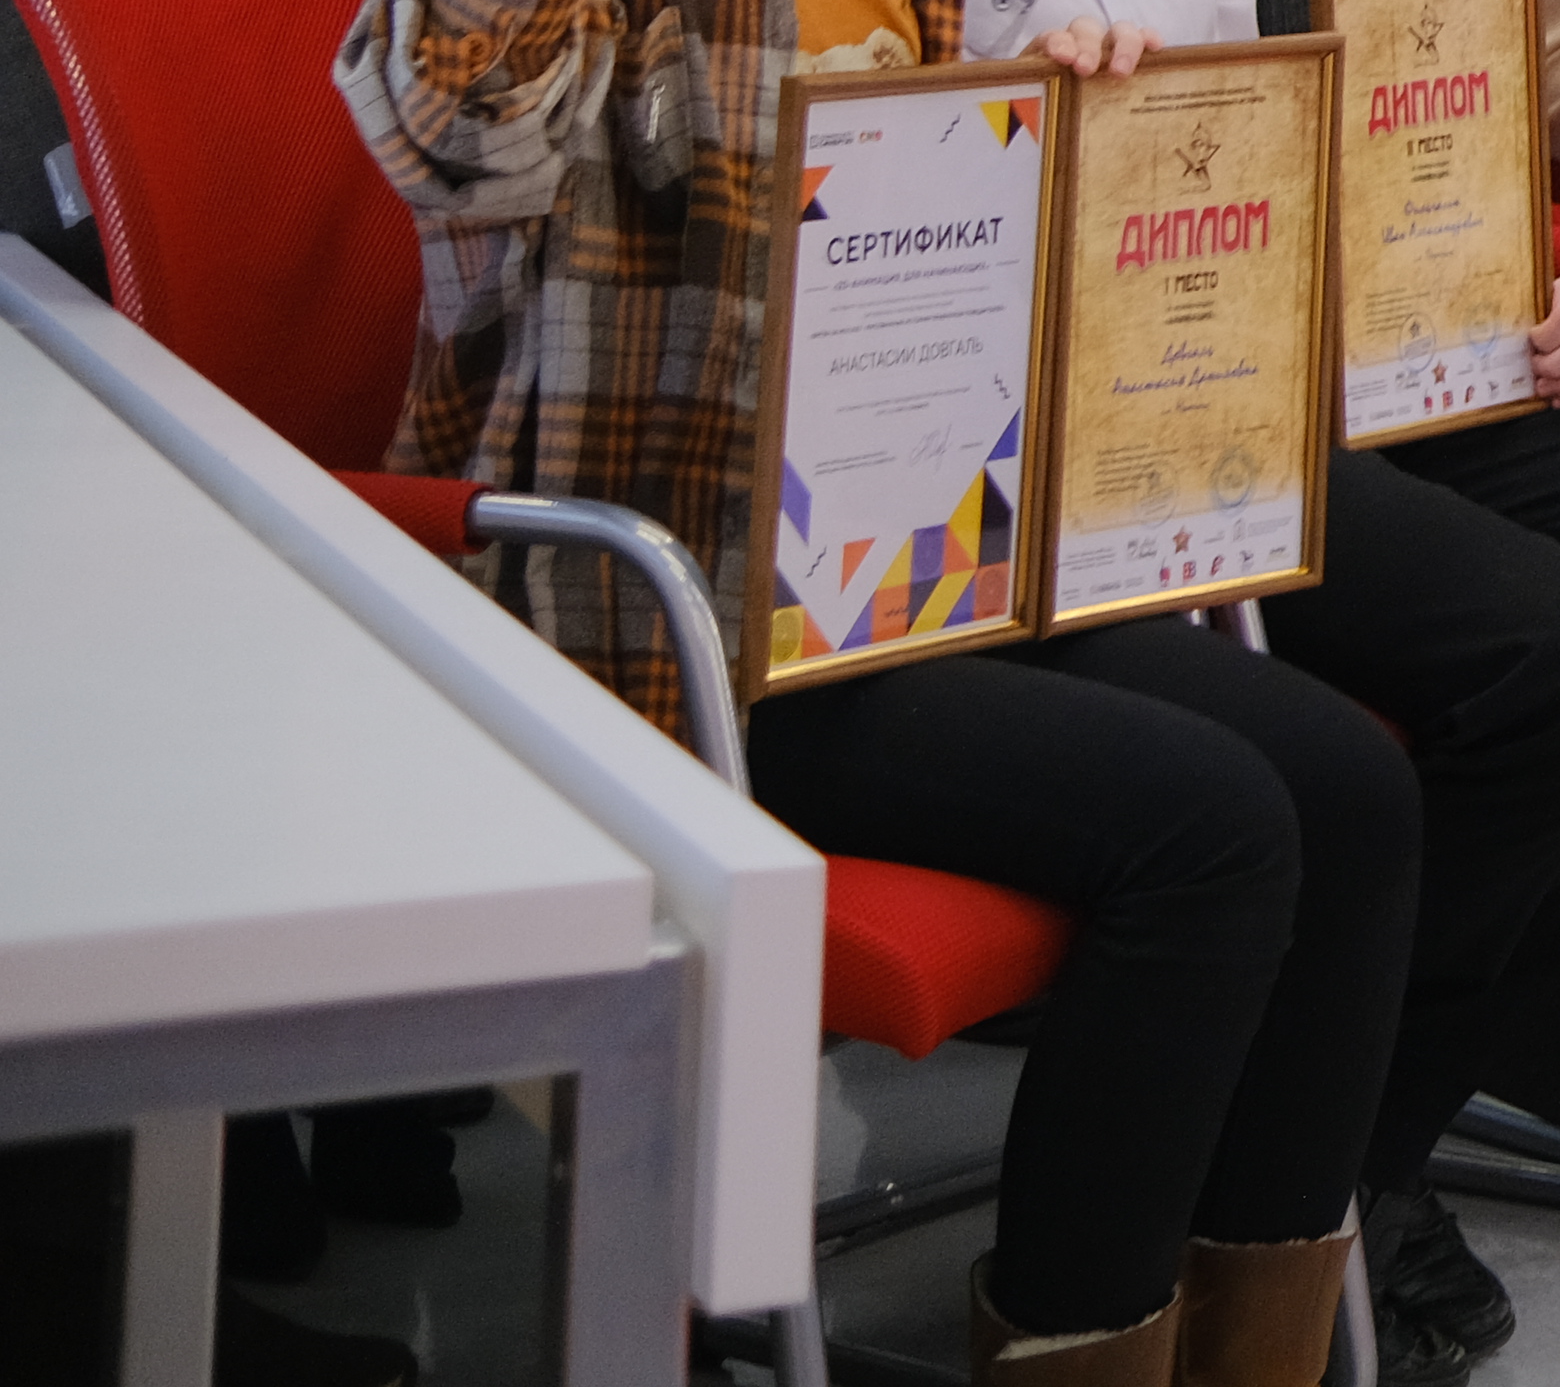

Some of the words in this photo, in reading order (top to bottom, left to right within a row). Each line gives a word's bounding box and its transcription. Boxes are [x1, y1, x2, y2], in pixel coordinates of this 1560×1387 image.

[1368, 69, 1490, 137] ДИПЛОМ
[1417, 133, 1454, 154] МЕСТО
[826, 217, 1004, 267] СЕРТИФИКАТ
[1115, 199, 1270, 273] ДИПЛОМ
[1174, 270, 1219, 295] МЕСТО
[828, 343, 916, 377] АНАСТАСИИ
[918, 334, 984, 365] ДОВГАЛЬ
